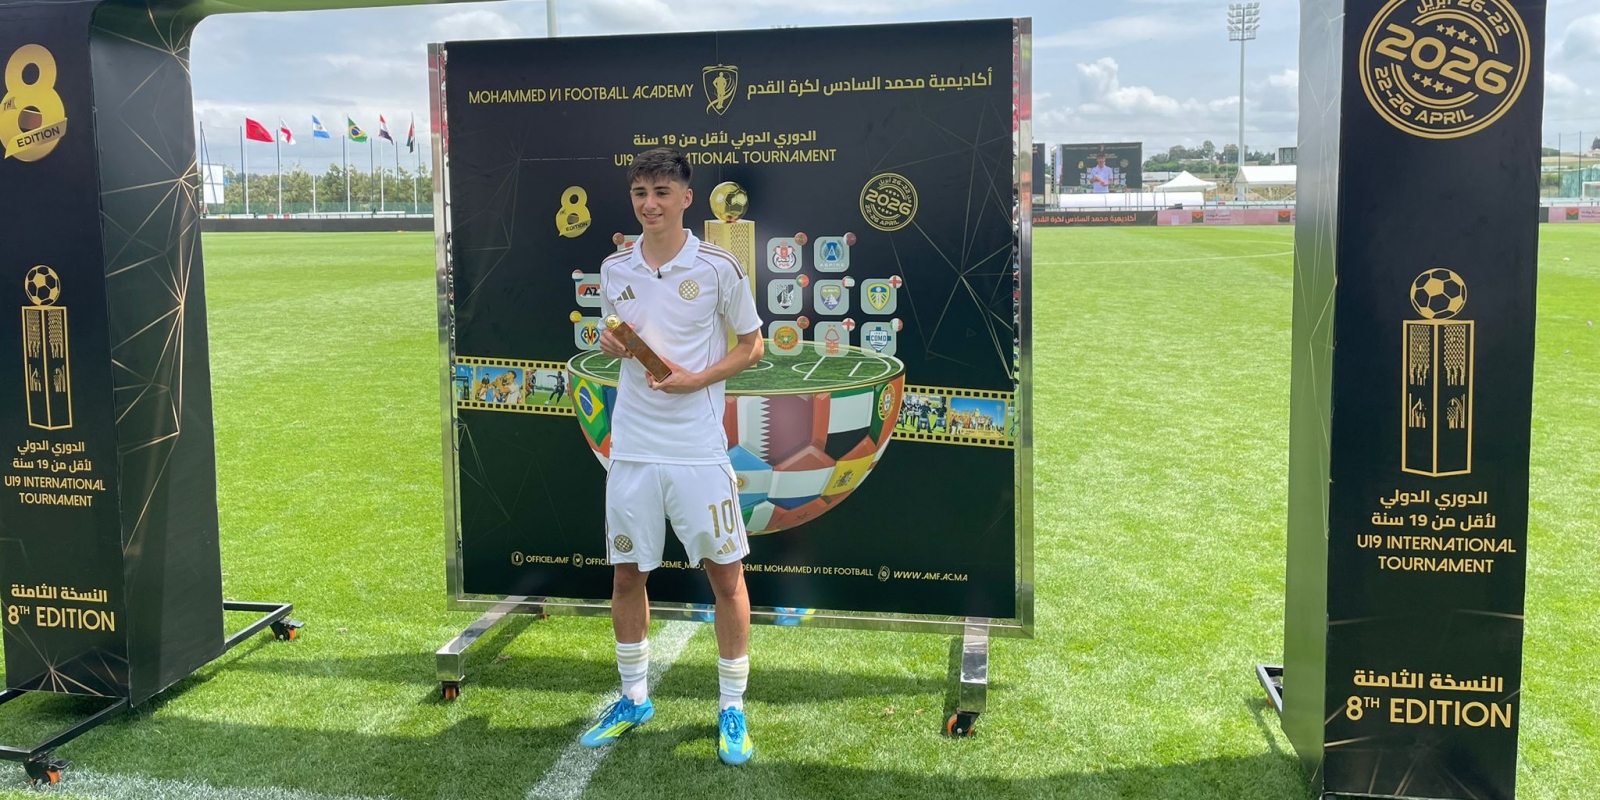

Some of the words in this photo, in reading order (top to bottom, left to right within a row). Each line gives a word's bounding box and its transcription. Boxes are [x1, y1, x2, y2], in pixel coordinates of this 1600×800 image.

[1375, 23, 1514, 94] 2026
[789, 79, 820, 97] لكرة
[824, 77, 880, 96] السادس
[885, 76, 924, 90] محمد
[929, 68, 992, 91] أكاديمية
[468, 88, 546, 104] MOHAMMED
[550, 88, 561, 102] VI
[565, 86, 628, 101] FOOTBALL
[632, 84, 694, 99] ACADEMY
[748, 80, 784, 100] القدم
[1374, 66, 1415, 116] 22-26
[1415, 109, 1474, 124] APRIL
[0, 43, 66, 162] 8
[16, 126, 60, 148] EDITION
[634, 134, 658, 146] سنة
[662, 134, 676, 145] 19
[679, 134, 697, 148] من
[700, 131, 728, 148] لأقل
[731, 132, 770, 149] الدولي
[774, 130, 816, 148] الدوري
[614, 154, 634, 166] U19
[743, 149, 836, 164] TOURNAMENT
[865, 188, 912, 216] 2026
[556, 186, 591, 238] 8
[1066, 215, 1090, 224] السادس
[1110, 213, 1136, 223] أكاديمية
[17, 440, 48, 455] الدولي
[52, 442, 84, 456] الدوري
[12, 458, 34, 469] سنة
[36, 459, 49, 469] 19
[51, 461, 66, 472] من
[69, 460, 92, 472] لأقل
[4, 476, 20, 487] U19
[24, 476, 106, 491] INTERNATIONAL
[19, 492, 92, 507] TOURNAMENT
[1380, 489, 1430, 508] الدولي
[1434, 491, 1488, 510] الدوري
[708, 498, 735, 538] 10
[1371, 512, 1404, 526] سنة
[1409, 514, 1428, 526] 19
[1431, 514, 1456, 530] من
[1460, 513, 1496, 532] لأقل
[1356, 534, 1382, 548] U19
[1386, 535, 1516, 553] INTERNATIONAL
[526, 555, 570, 564] OFFICIELAMF
[1378, 556, 1494, 574] TOURNAMENT
[764, 564, 812, 574] MOHAMMED
[814, 566, 822, 574] VI
[823, 566, 832, 575] DE
[834, 566, 873, 576] FOOTBALL
[11, 583, 57, 599] الثامنة
[60, 586, 108, 602] النسخة
[36, 606, 116, 632] EDITION
[1353, 669, 1424, 688] الثامنة
[1429, 673, 1503, 692] النسخة
[1390, 698, 1512, 728] EDITION
